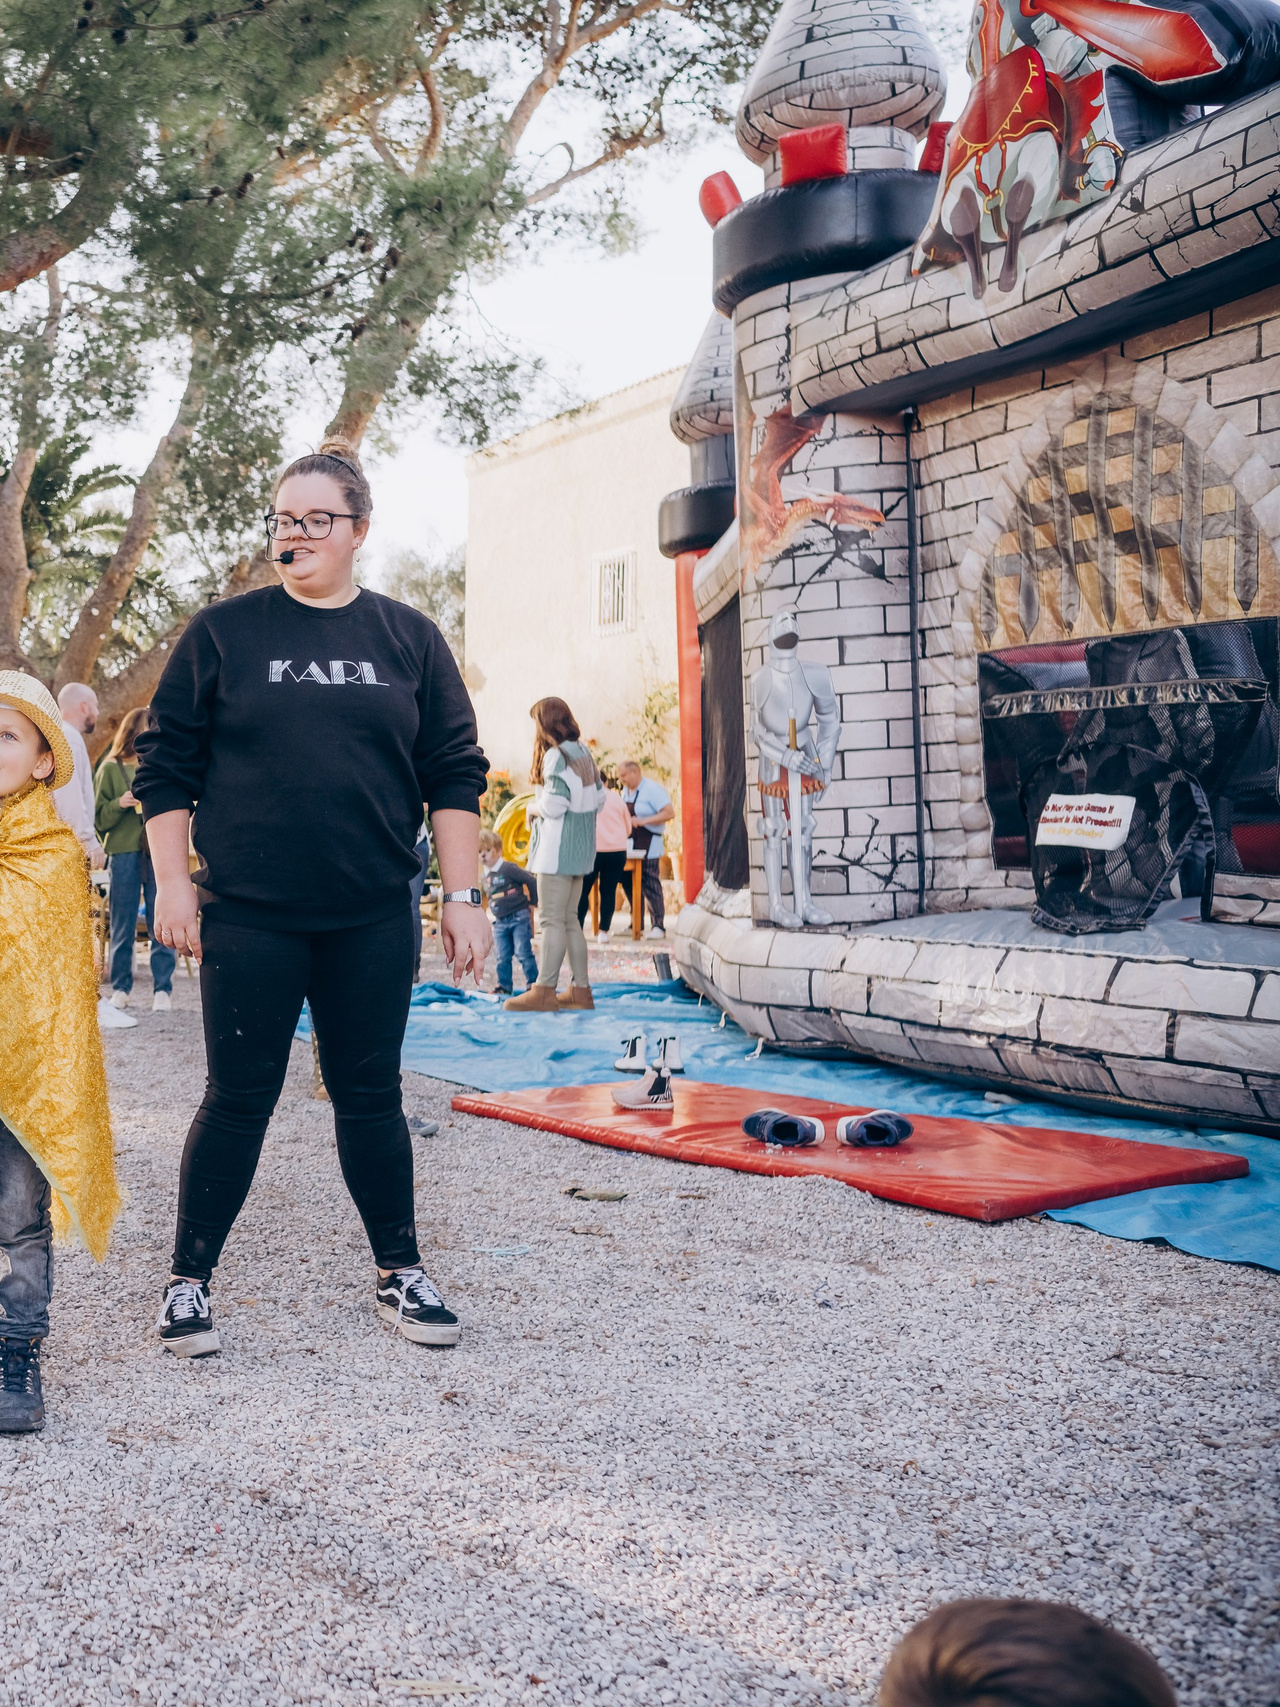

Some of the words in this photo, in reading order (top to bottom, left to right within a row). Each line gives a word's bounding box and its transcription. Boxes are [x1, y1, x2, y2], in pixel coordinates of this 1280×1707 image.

[269, 660, 390, 687] KARL
[1084, 803, 1106, 813] Game
[1071, 815, 1084, 824] Not
